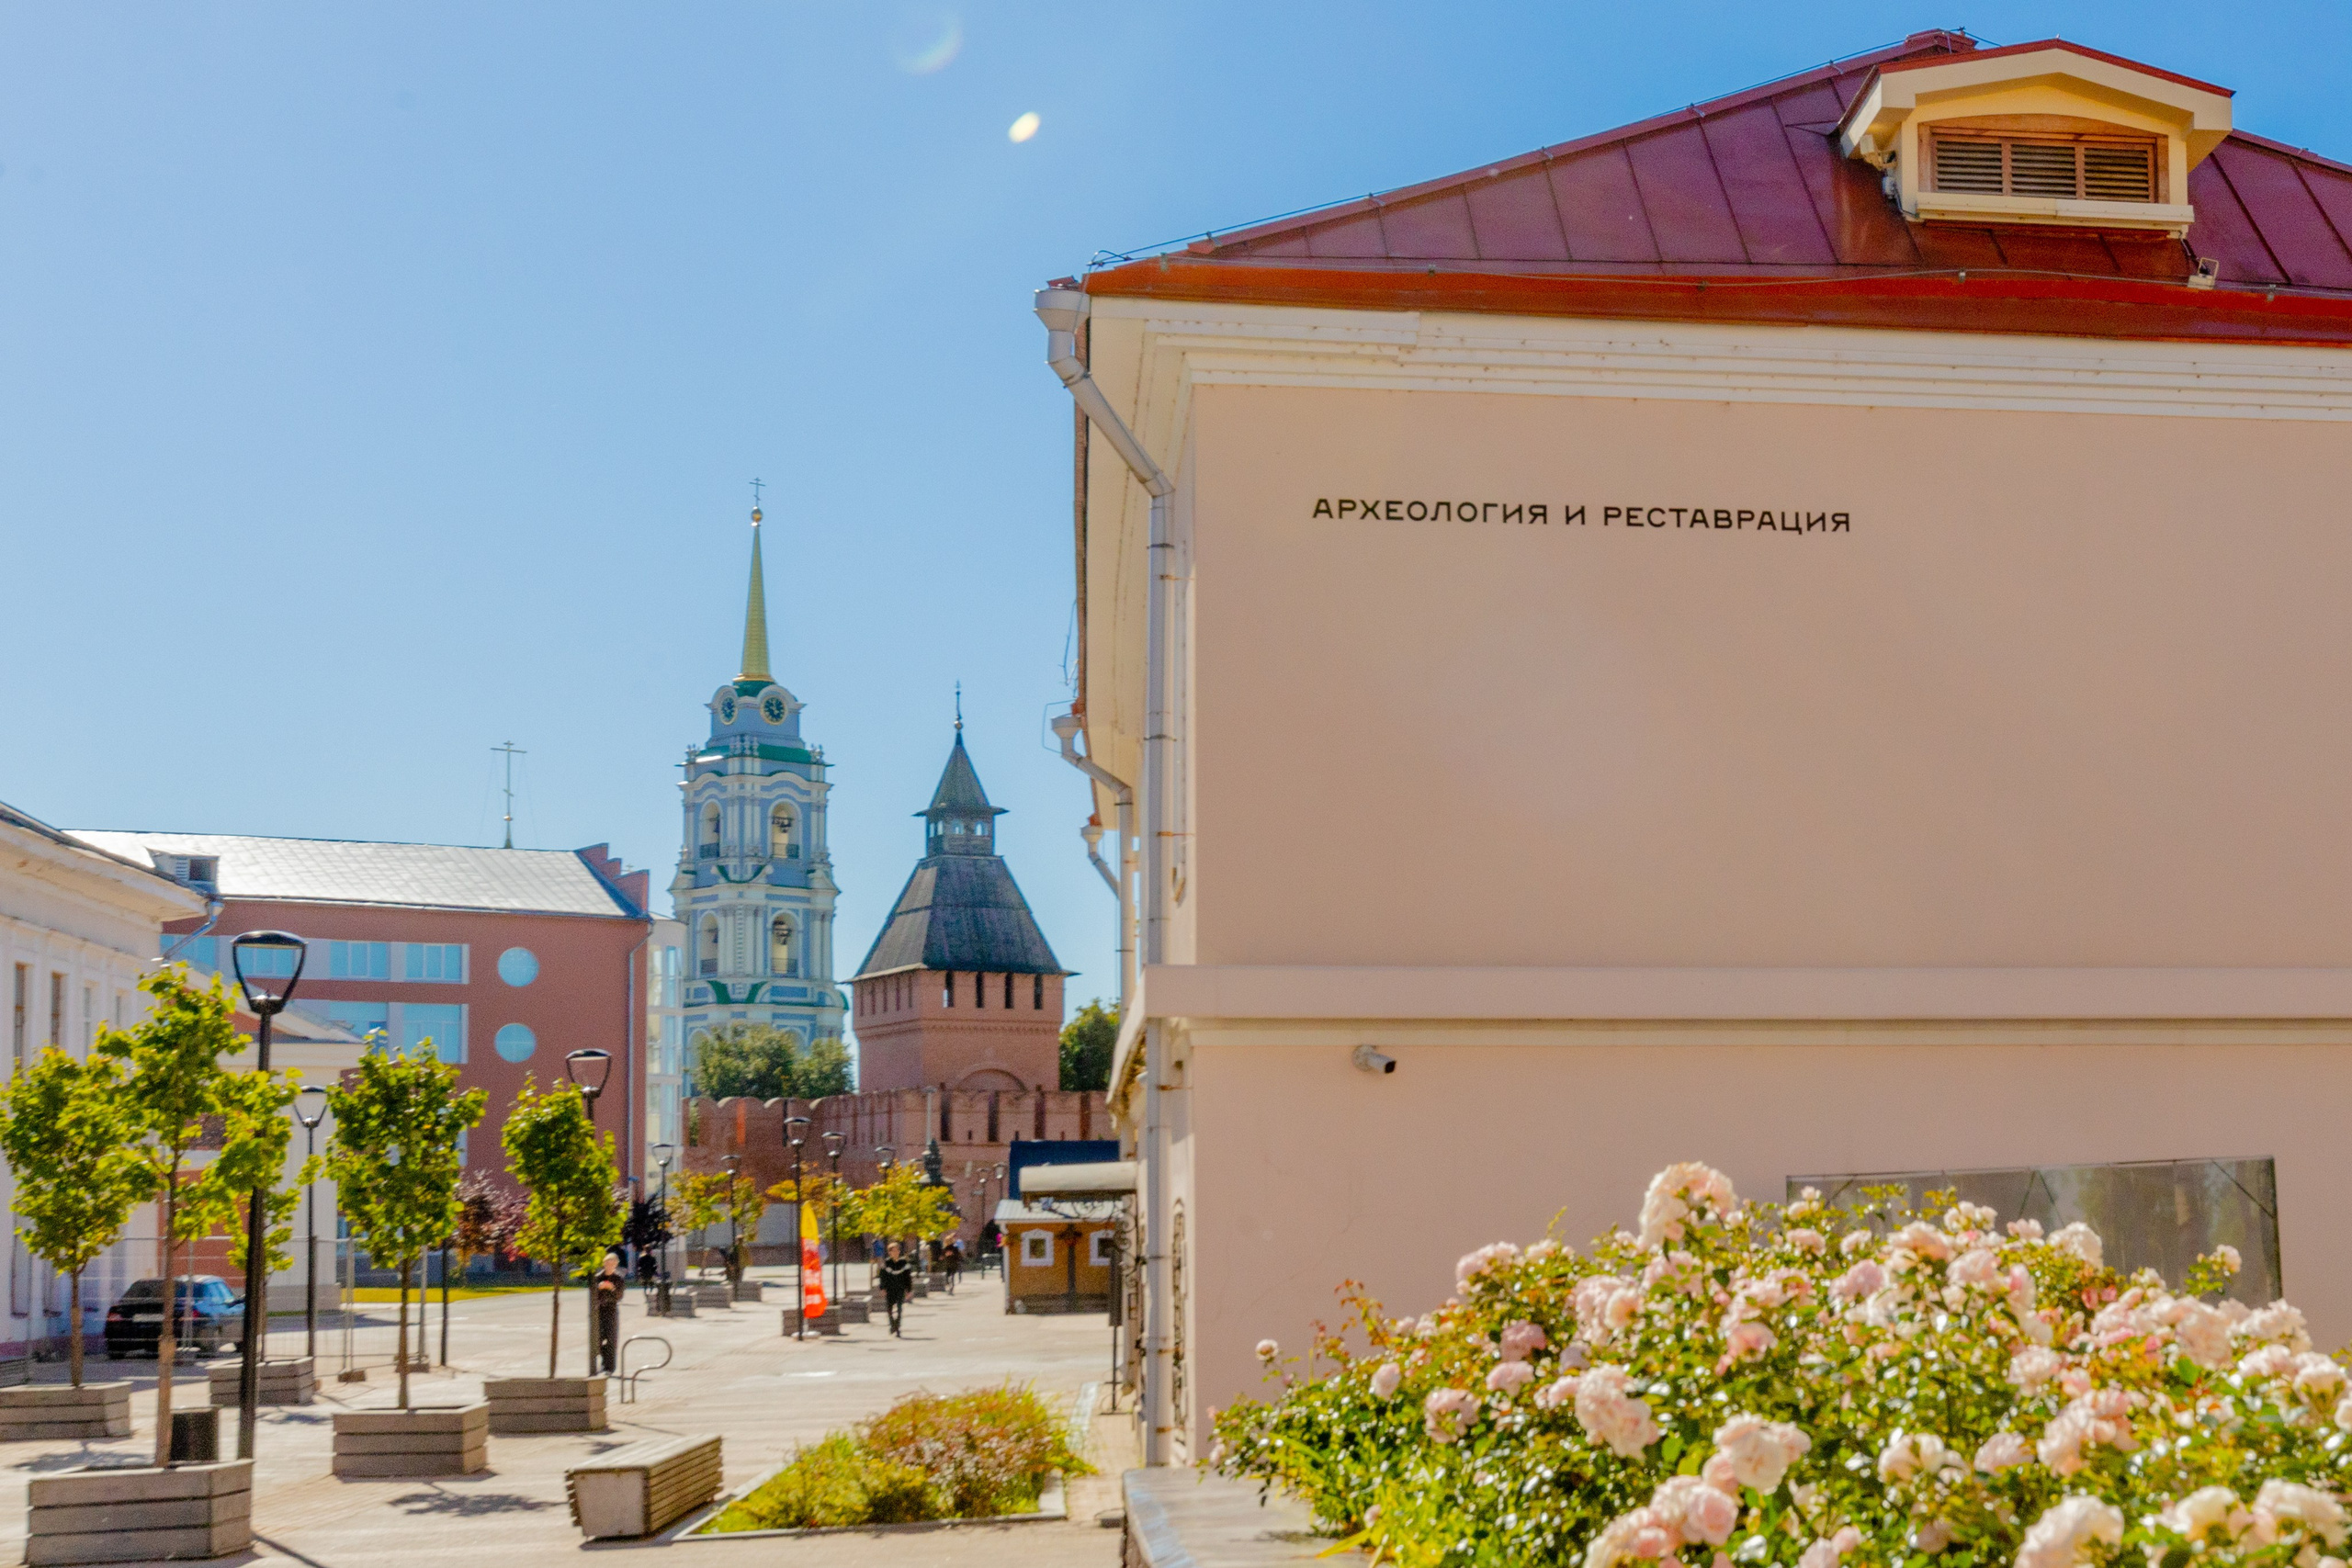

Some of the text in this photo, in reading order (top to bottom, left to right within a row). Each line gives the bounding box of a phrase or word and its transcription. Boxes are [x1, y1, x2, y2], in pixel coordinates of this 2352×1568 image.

[1312, 498, 1850, 536] АРХЕОЛОГИЯ И РЕСТАВРАЦИЯ
